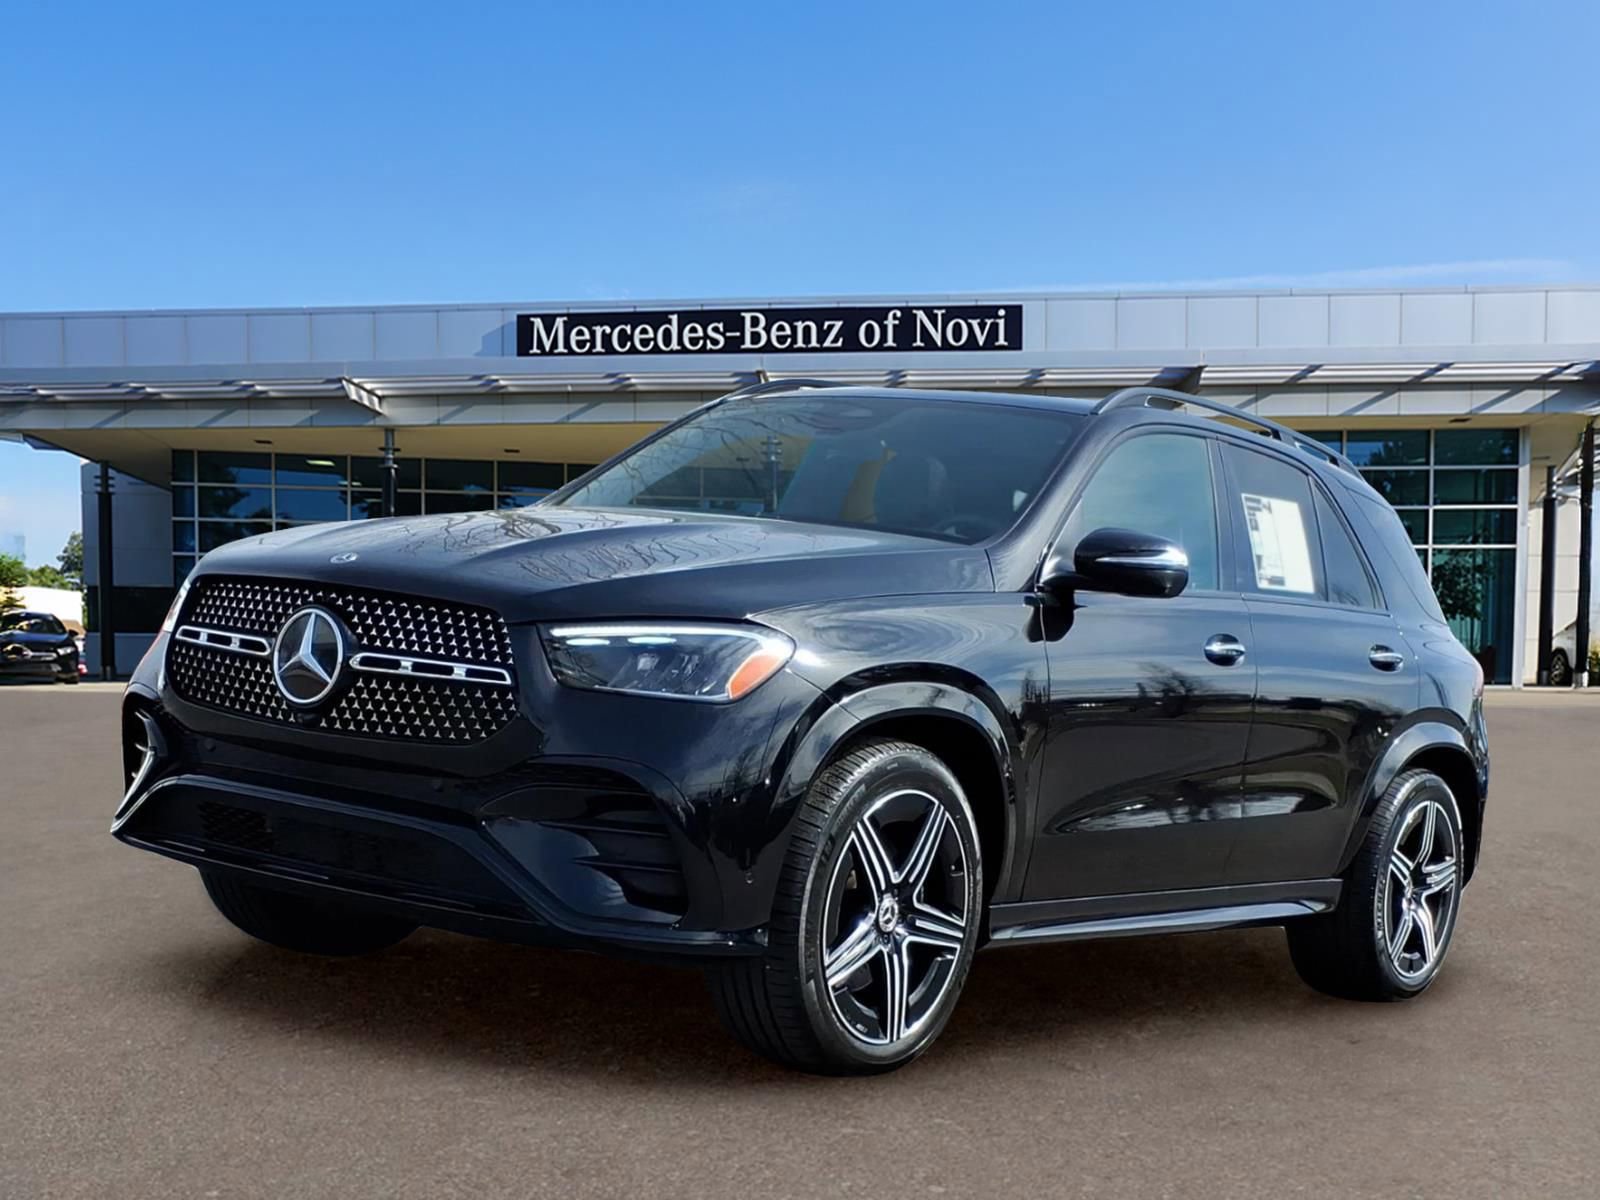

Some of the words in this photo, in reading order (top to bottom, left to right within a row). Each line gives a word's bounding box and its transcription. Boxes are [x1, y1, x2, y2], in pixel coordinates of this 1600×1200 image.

[529, 312, 844, 354] Mercedes-Benz
[858, 309, 902, 348] of
[912, 308, 1009, 347] Novi
